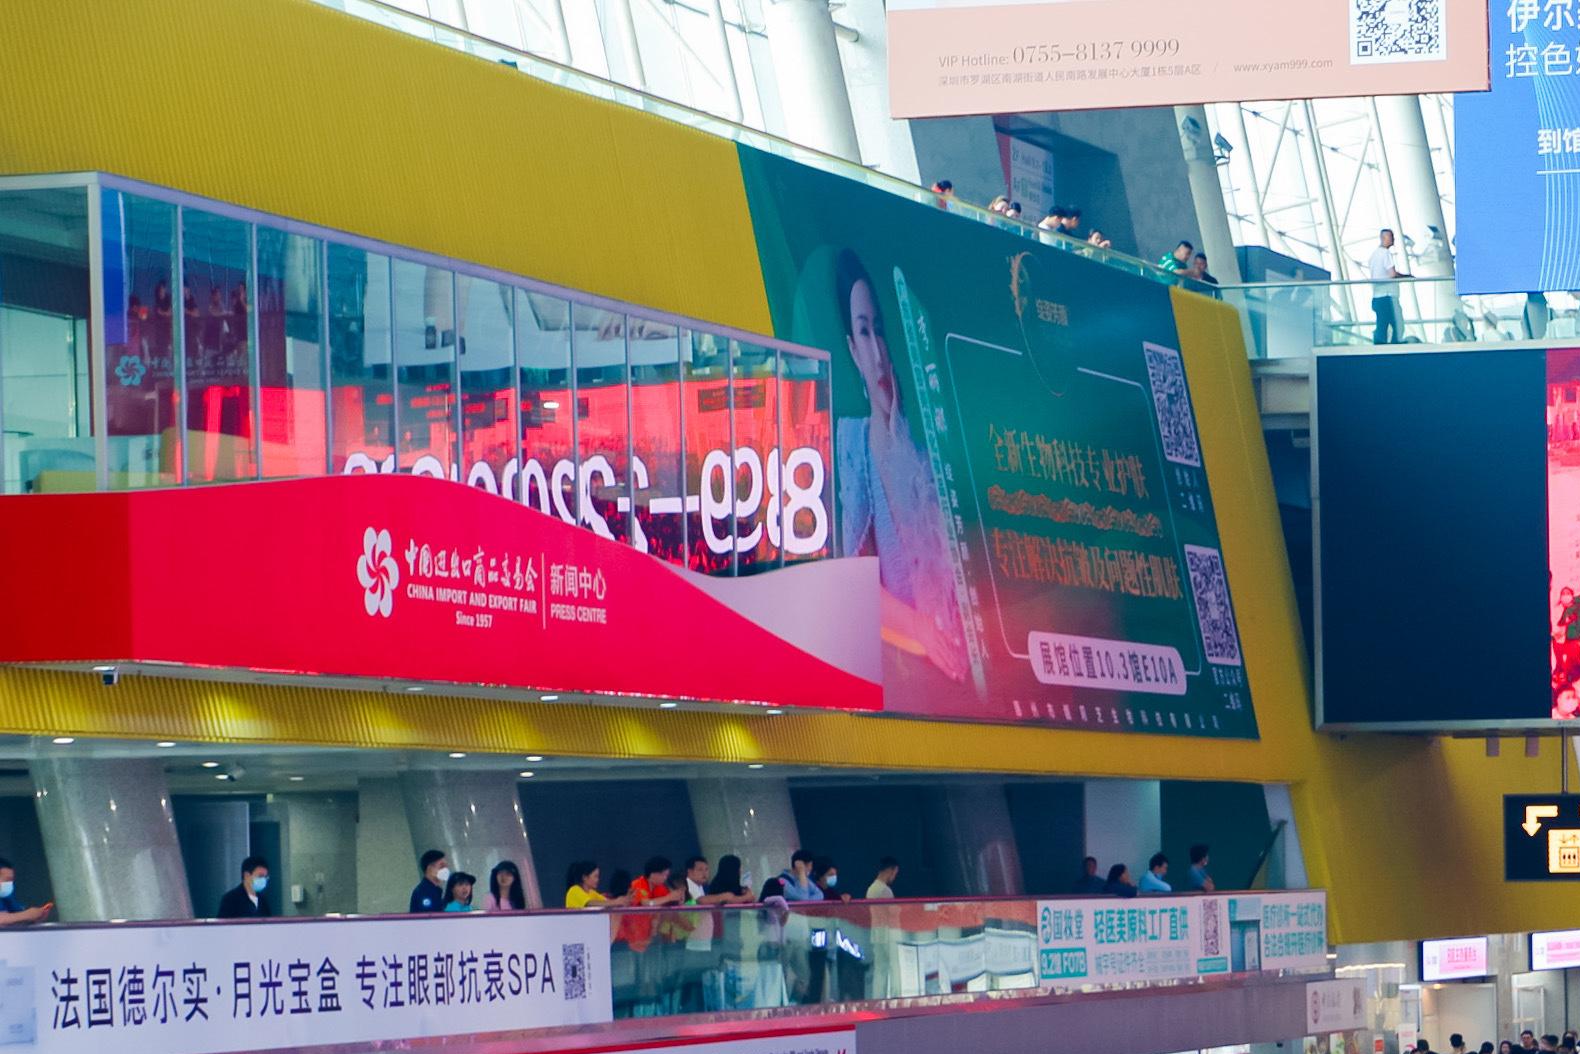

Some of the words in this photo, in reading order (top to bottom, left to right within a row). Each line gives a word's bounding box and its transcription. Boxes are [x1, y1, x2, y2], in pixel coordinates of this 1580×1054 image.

[938, 56, 959, 68] VIP
[962, 54, 1010, 68] Hotline:
[1130, 39, 1180, 57] 9999
[550, 562, 607, 601] 新闻中心
[407, 583, 434, 601] CHINA
[436, 586, 467, 605] IMPORT
[469, 590, 487, 608] AND
[488, 592, 518, 612] EXPORT
[519, 596, 538, 614] FAIR
[455, 610, 474, 628] Since
[475, 613, 493, 629] 1957
[550, 603, 577, 622] PRESS
[577, 605, 607, 625] CENTRE
[355, 949, 556, 1011] 专注眼部抗衰SPA
